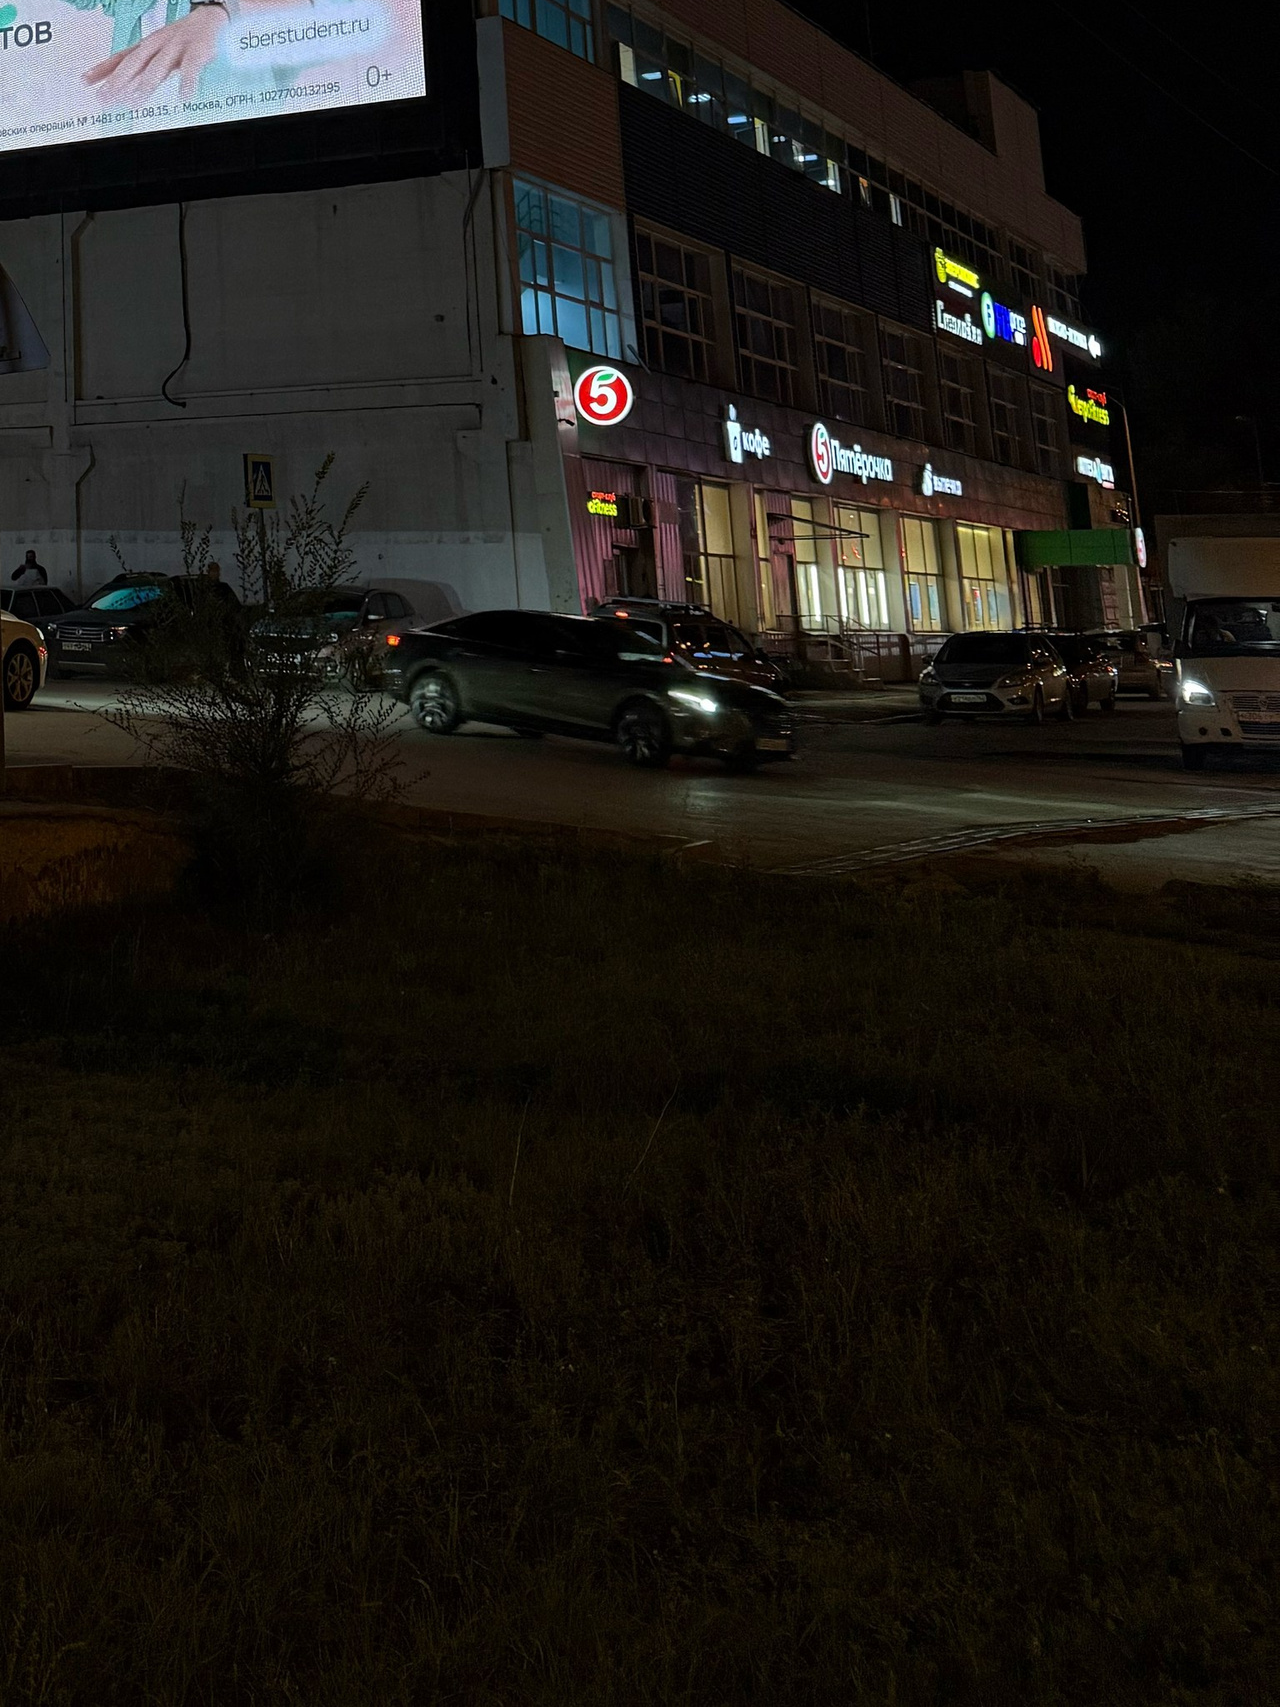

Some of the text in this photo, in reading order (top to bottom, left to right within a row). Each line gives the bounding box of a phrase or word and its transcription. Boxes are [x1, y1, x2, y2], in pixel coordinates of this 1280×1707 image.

[239, 18, 370, 51] sberstudent.ru
[30, 118, 75, 134] операций
[91, 112, 112, 125] 1481
[115, 112, 126, 122] от
[183, 100, 223, 113] Москва,
[260, 82, 341, 103] 1027700132195
[589, 370, 617, 415] 5
[742, 428, 770, 460] кофе
[831, 439, 893, 485] Пятёрочка
